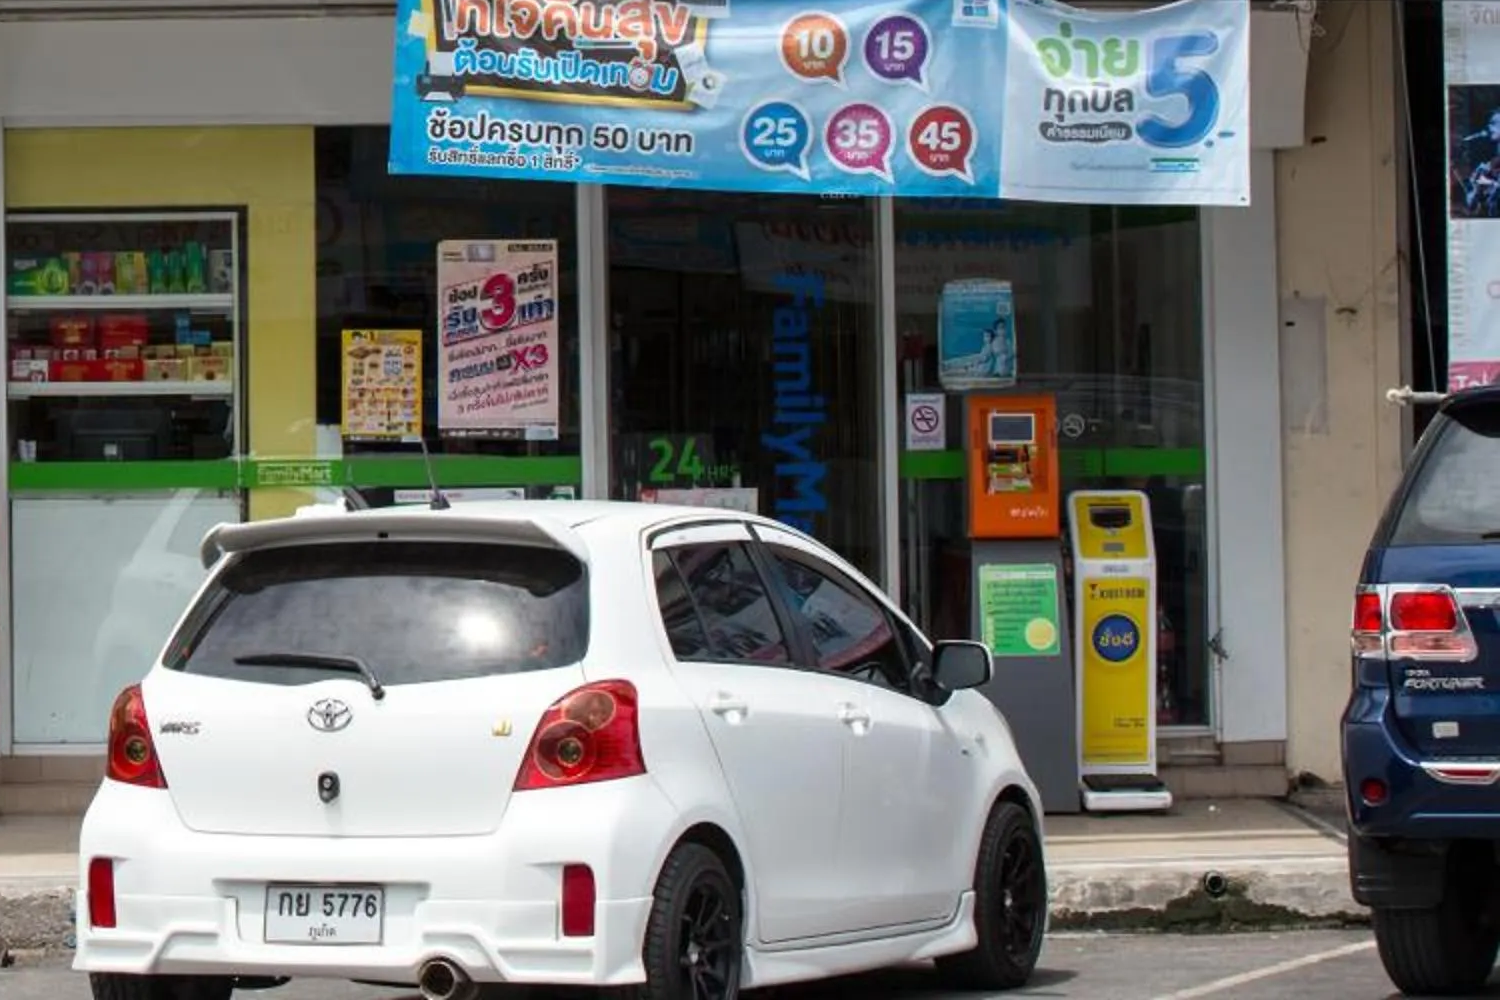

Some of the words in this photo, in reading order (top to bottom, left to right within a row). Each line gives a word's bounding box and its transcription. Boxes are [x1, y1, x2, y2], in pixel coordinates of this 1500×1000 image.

[796, 29, 835, 59] 10
[876, 31, 915, 60] 15
[1036, 20, 1140, 79] จ่าย
[1043, 81, 1135, 122] ทุกบิล
[428, 110, 584, 154] ช้อปครบทุก
[593, 126, 629, 150] 50
[638, 130, 693, 153] บาท
[753, 117, 797, 147] 25
[835, 119, 879, 149] 35
[918, 121, 961, 151] 45
[479, 273, 516, 332] 3
[649, 437, 703, 482] 24
[278, 891, 312, 918] กย
[323, 892, 378, 919] 5776
